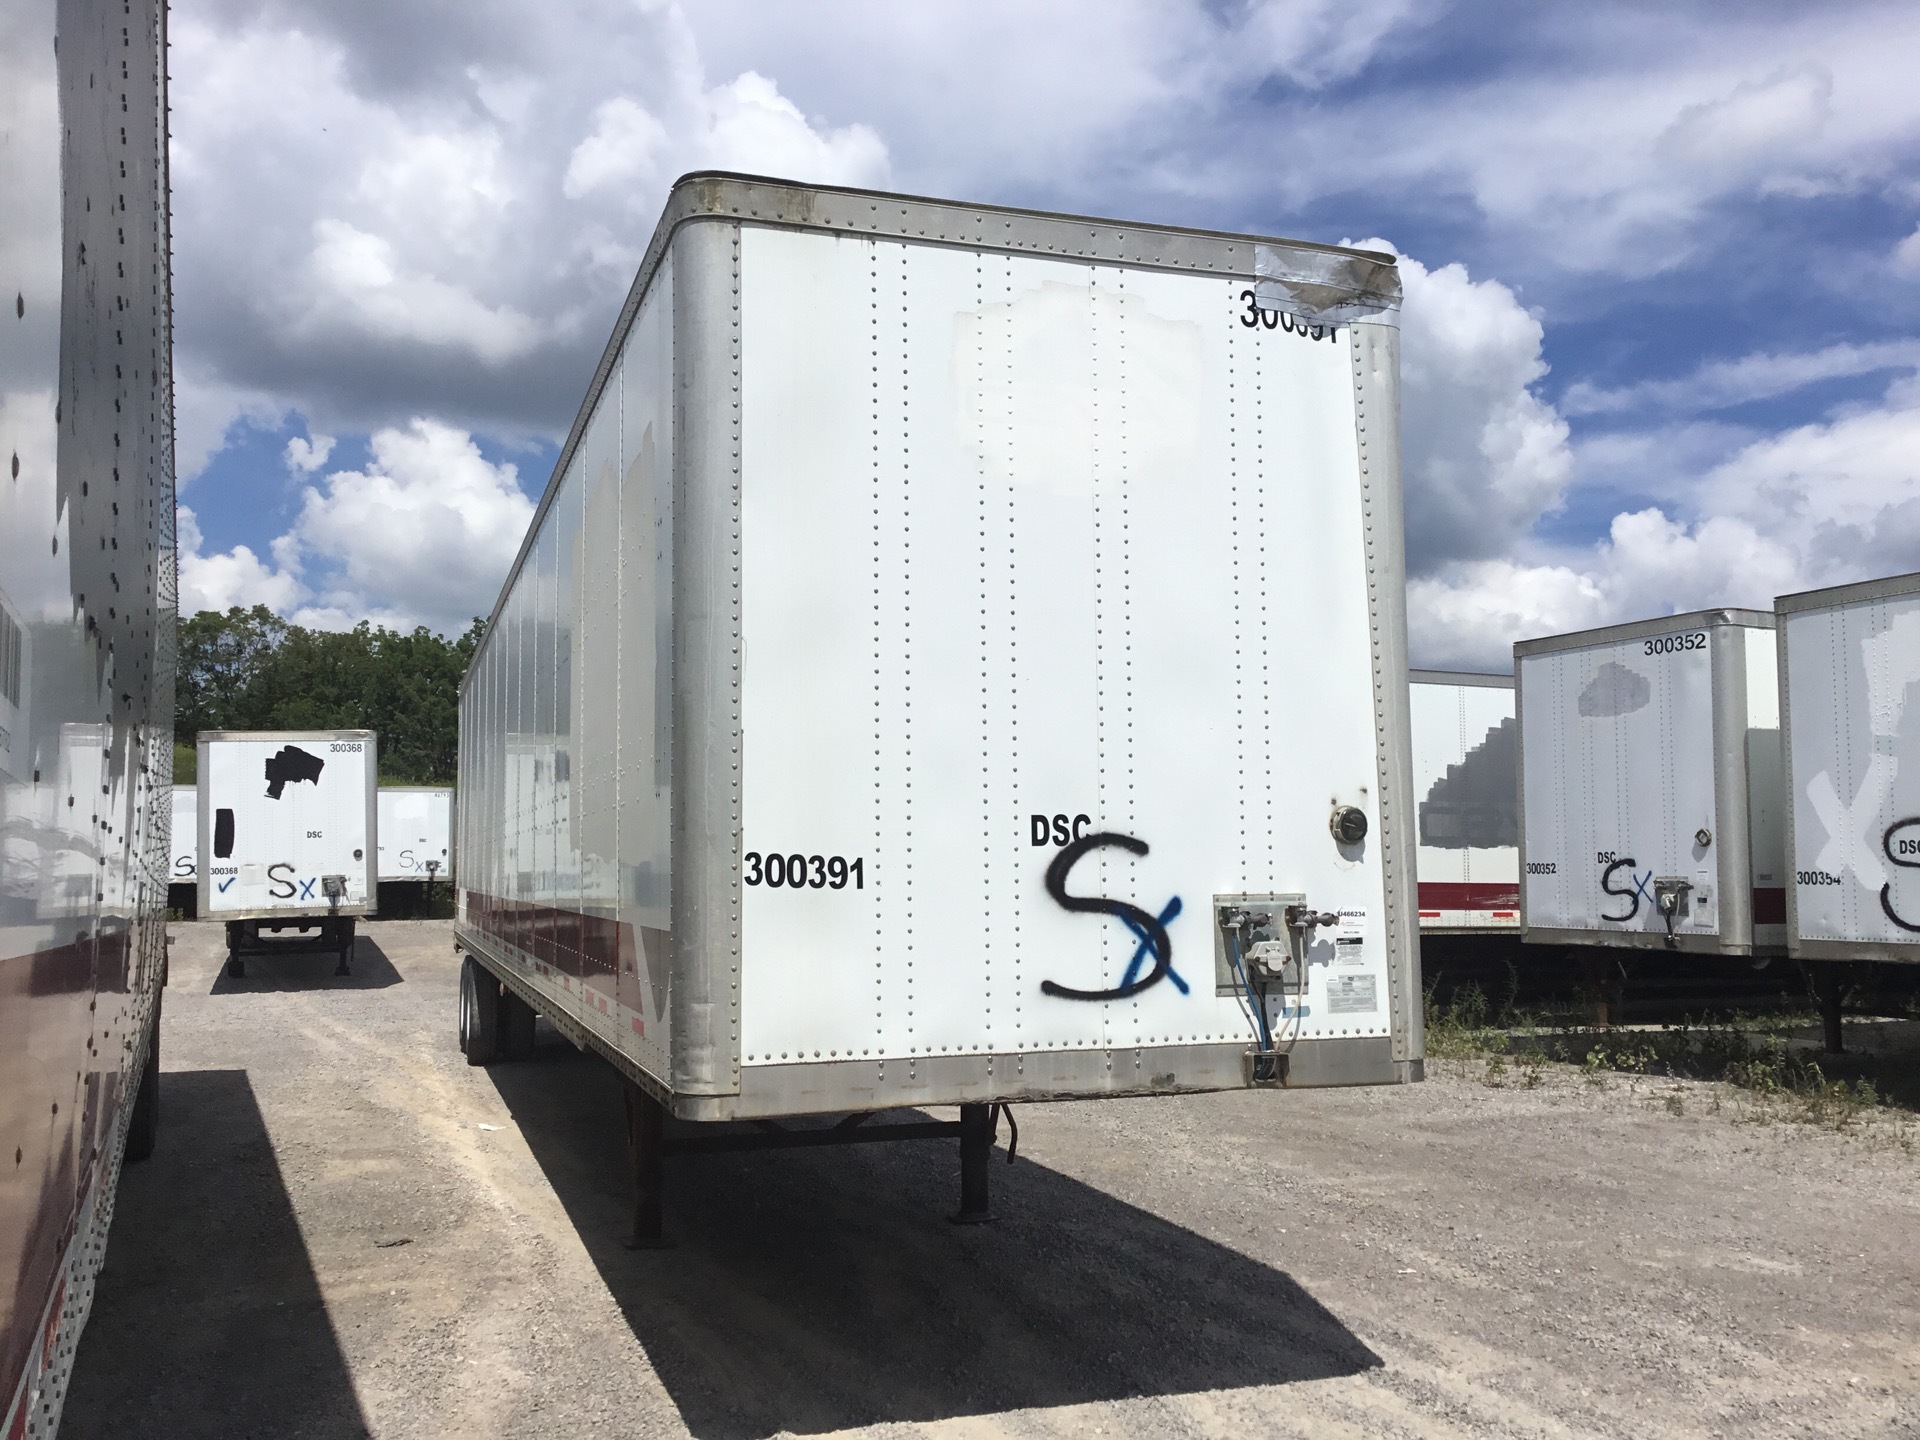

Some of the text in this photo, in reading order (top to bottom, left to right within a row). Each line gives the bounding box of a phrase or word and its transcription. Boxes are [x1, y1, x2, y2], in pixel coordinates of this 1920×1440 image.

[1644, 633, 1706, 656] 300352
[330, 743, 362, 753] 300368
[307, 831, 322, 839] DSC
[1031, 814, 1092, 847] DSC
[1597, 852, 1616, 864] DSC
[210, 867, 238, 875] 300368
[744, 852, 864, 889] 300391
[1526, 863, 1557, 875] 300352
[1797, 871, 1841, 886] 300354
